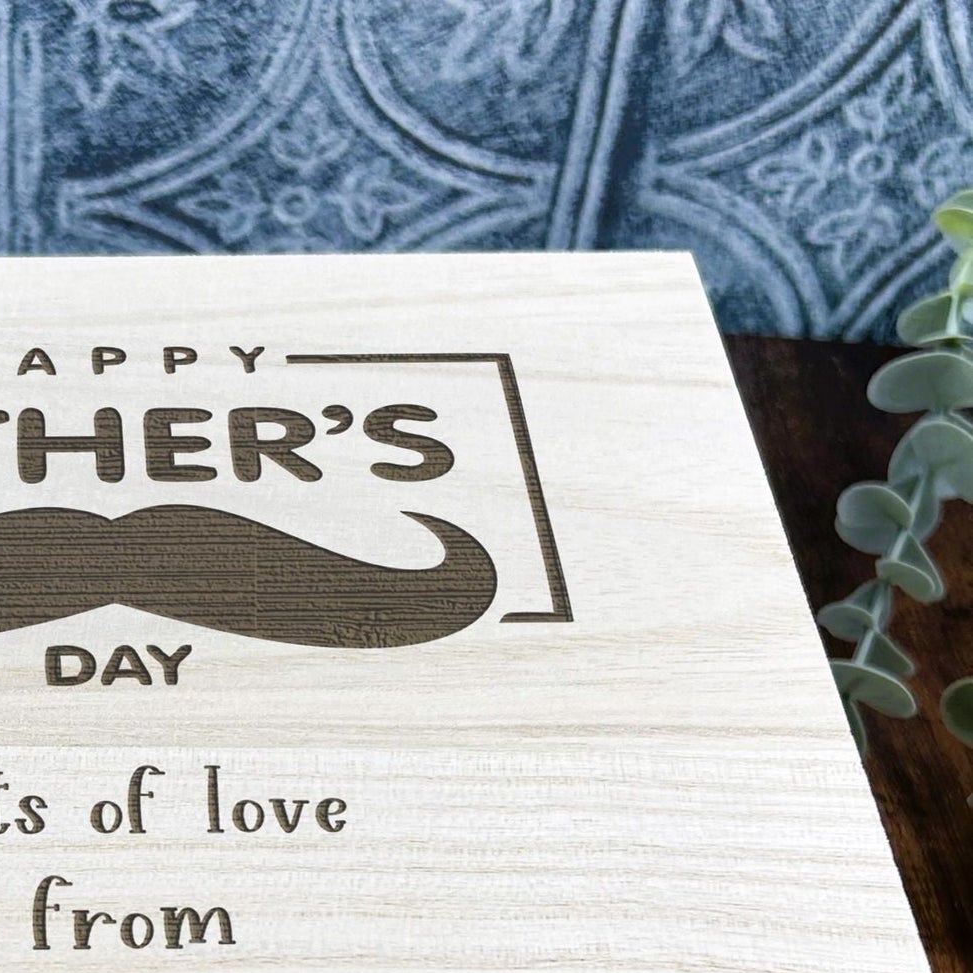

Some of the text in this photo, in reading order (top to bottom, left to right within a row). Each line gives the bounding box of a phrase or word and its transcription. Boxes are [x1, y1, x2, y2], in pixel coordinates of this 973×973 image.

[44, 644, 193, 687] DAY
[90, 765, 166, 834] of
[203, 764, 347, 834] love
[32, 875, 237, 951] from
